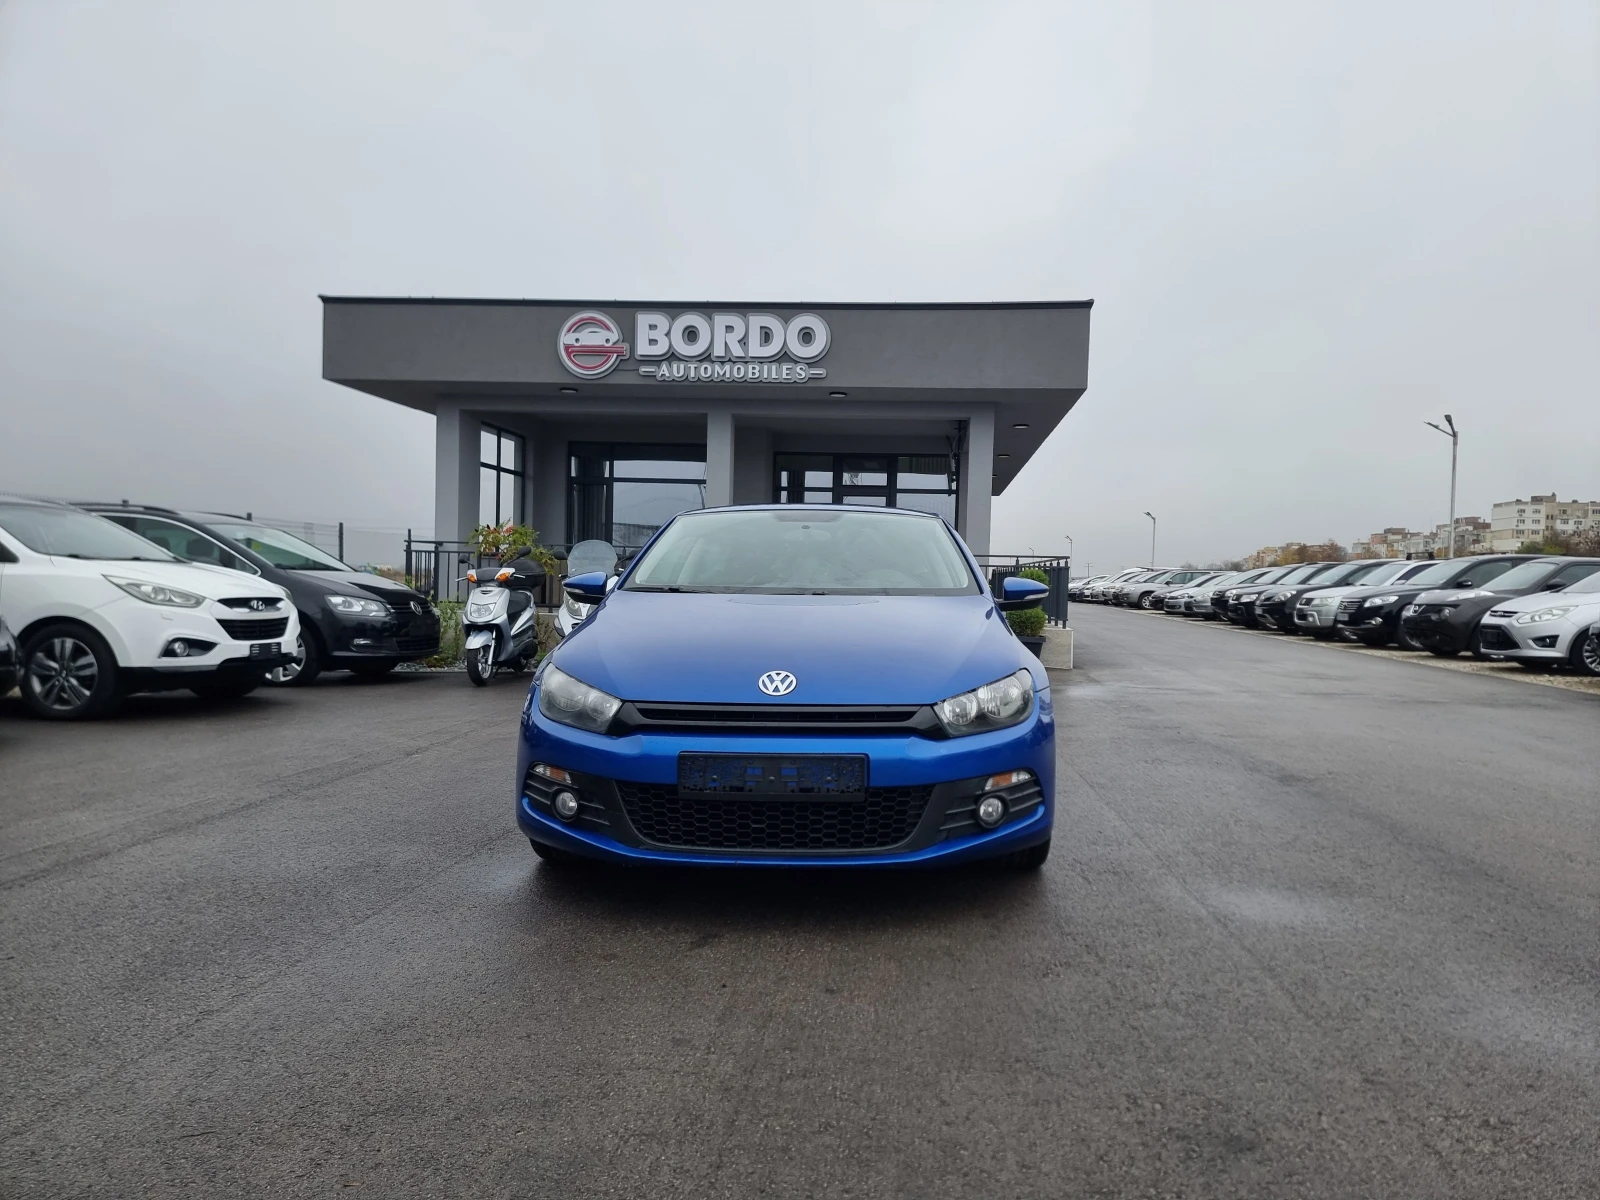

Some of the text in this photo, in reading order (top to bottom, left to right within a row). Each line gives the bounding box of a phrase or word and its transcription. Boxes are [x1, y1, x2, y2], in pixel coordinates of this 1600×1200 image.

[636, 313, 828, 358] BORDO
[657, 363, 807, 380] AUTOMOBILES
[758, 670, 797, 696] VW
